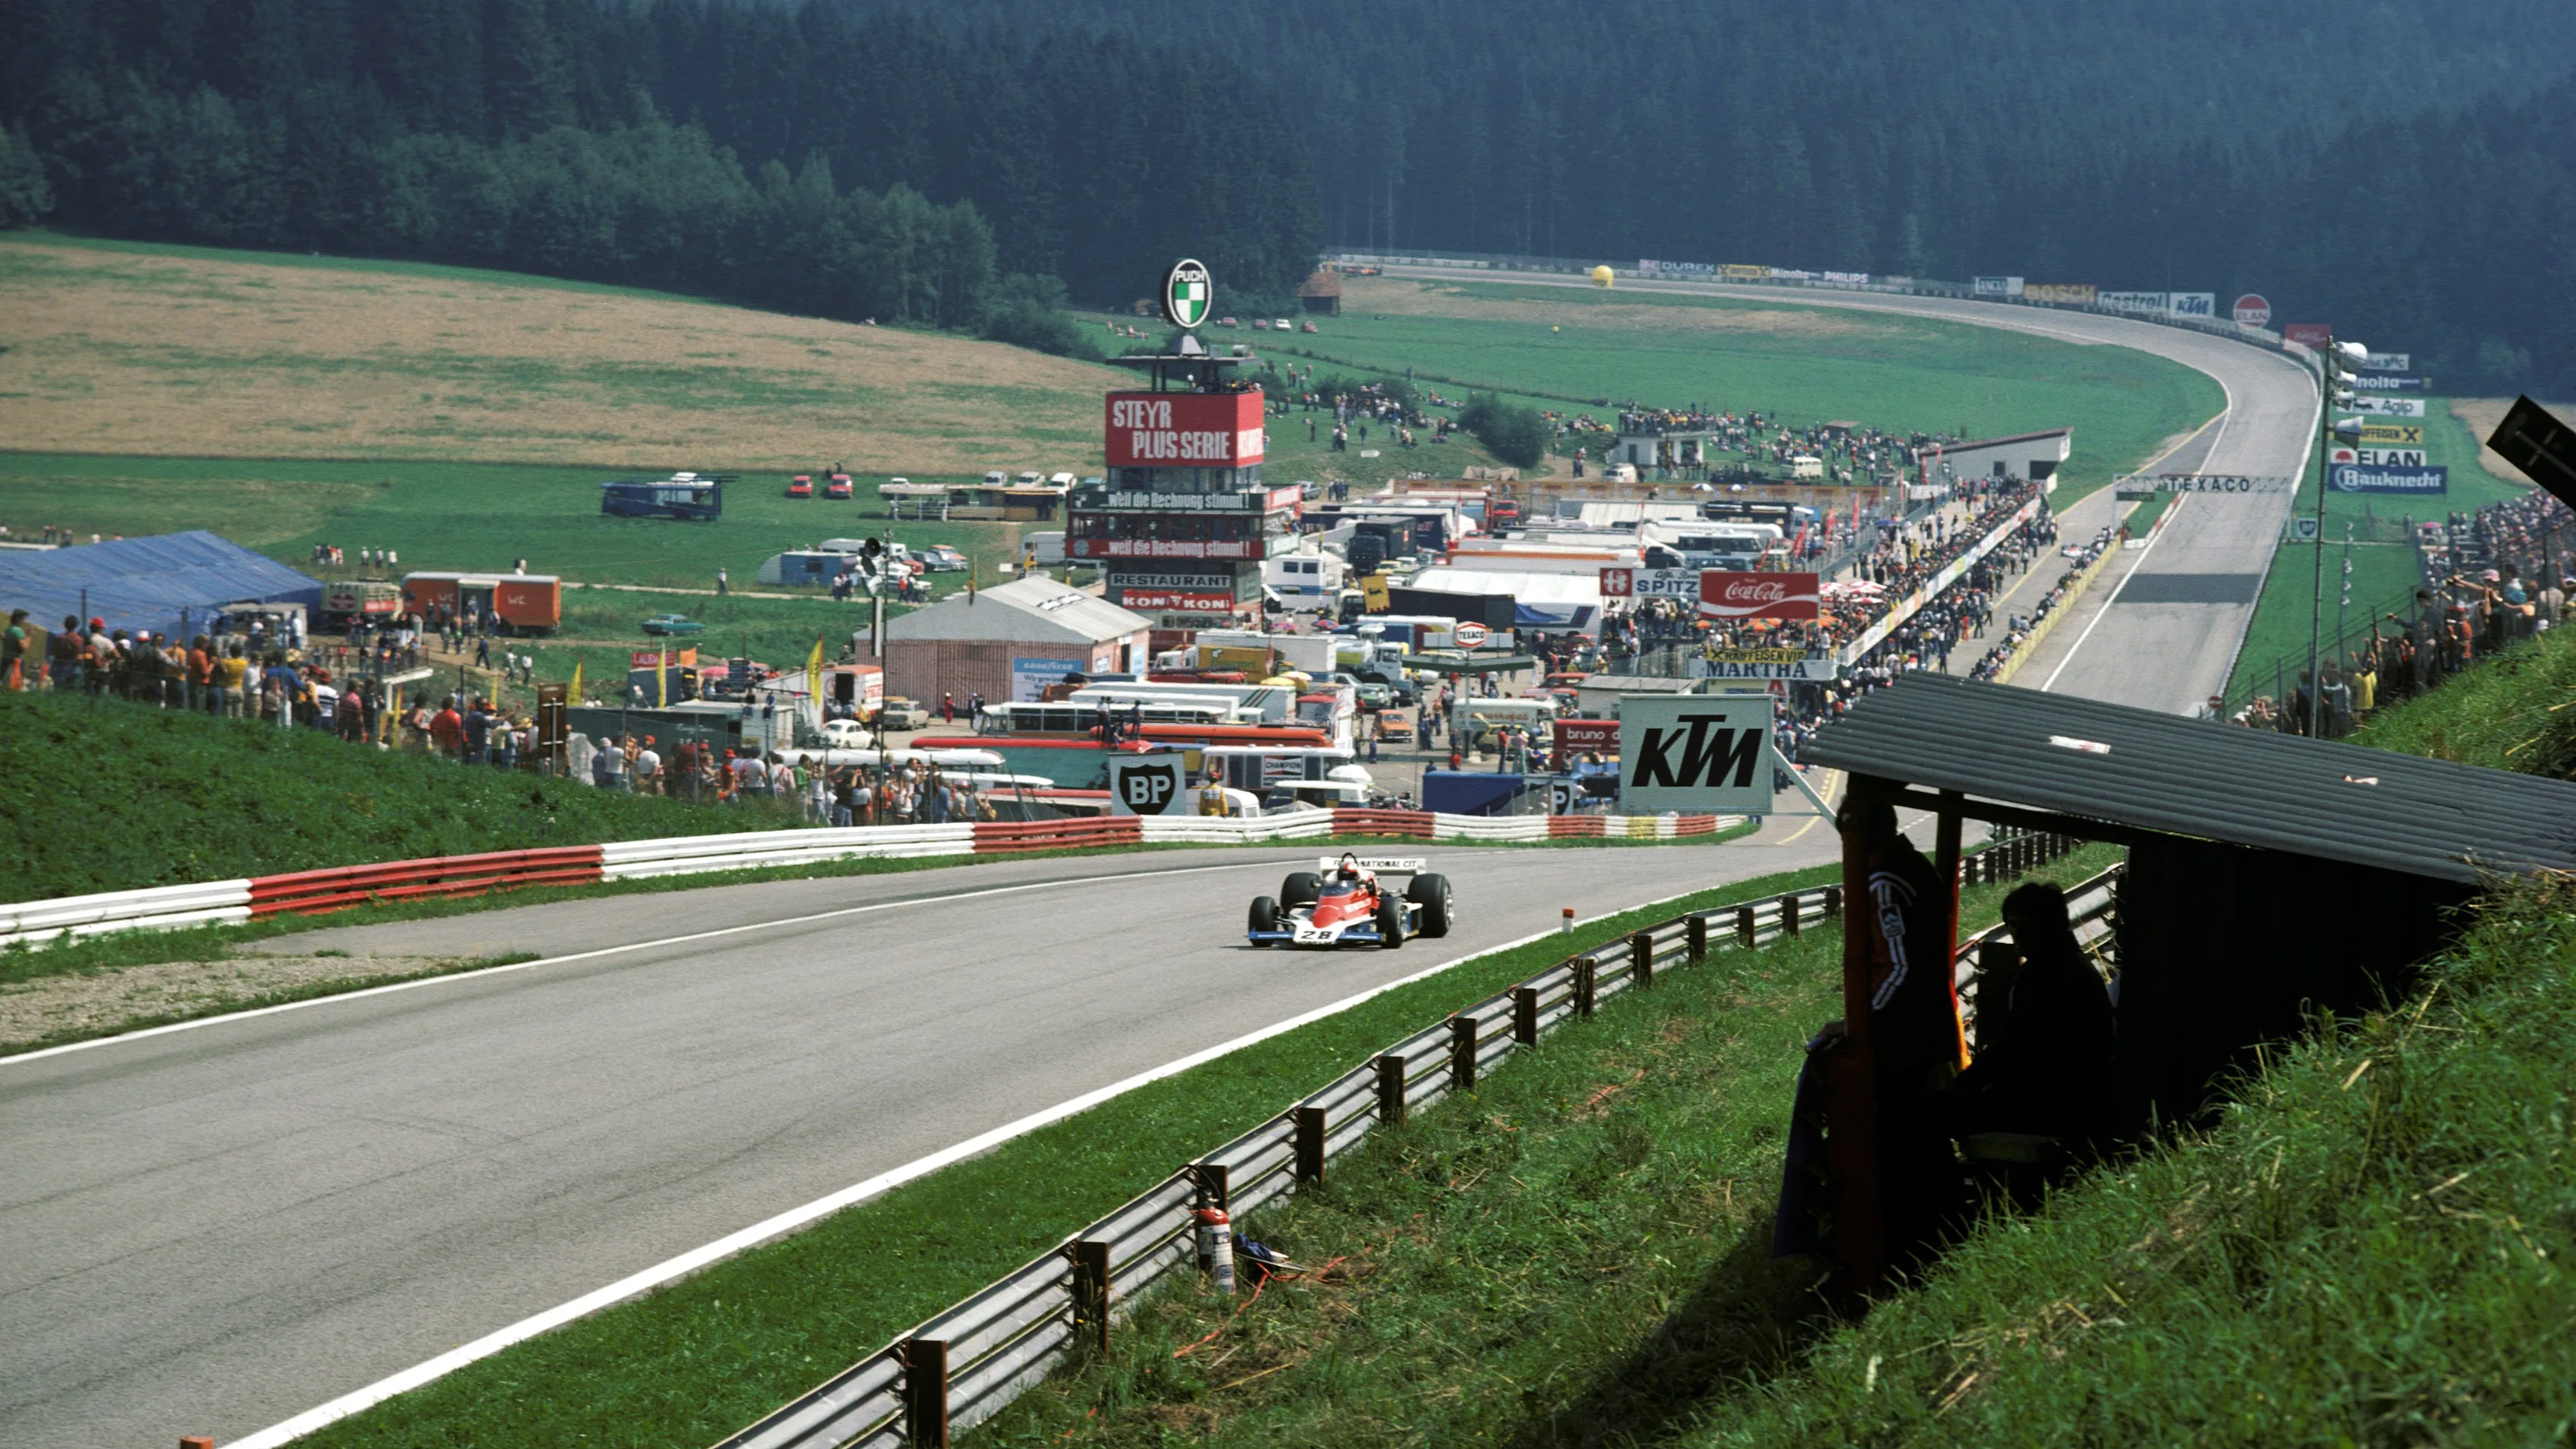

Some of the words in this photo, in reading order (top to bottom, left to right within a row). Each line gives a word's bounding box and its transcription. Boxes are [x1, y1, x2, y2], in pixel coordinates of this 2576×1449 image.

[1662, 261, 1714, 273] DUREX
[1175, 270, 1204, 282] PUCH
[1824, 270, 1868, 283] PHILIPS
[2025, 284, 2096, 303] BOSCH
[2102, 293, 2164, 311] Castrol
[2177, 296, 2209, 314] KTM
[2235, 311, 2268, 320] ELAN
[2354, 376, 2401, 388] nolta
[1113, 400, 1171, 428] STEYR
[2382, 399, 2414, 415] Agip
[1132, 431, 1178, 459] PLUS
[1180, 431, 1230, 459] SERIE
[2357, 450, 2421, 466] ELAN
[2169, 477, 2250, 492] TEXACO
[2343, 469, 2442, 487] Bauknecht
[1133, 493, 1149, 507] die
[1151, 493, 1204, 510] Rechnung
[1134, 540, 1150, 554] die
[1152, 540, 1204, 557] Rechnung
[1114, 575, 1228, 586] RESTAURANT
[1637, 579, 1697, 592] SPITZ
[1725, 581, 1786, 600] Coca-Cola
[1459, 631, 1485, 639] TEXACO
[1725, 649, 1784, 661] RAIFFEISEN
[1785, 649, 1805, 661] VIP
[1706, 661, 1807, 678] MARTHA
[1567, 727, 1605, 740] bruno
[1631, 715, 1764, 788] KTM
[1128, 775, 1170, 804] BP
[1301, 931, 1333, 939] 28
